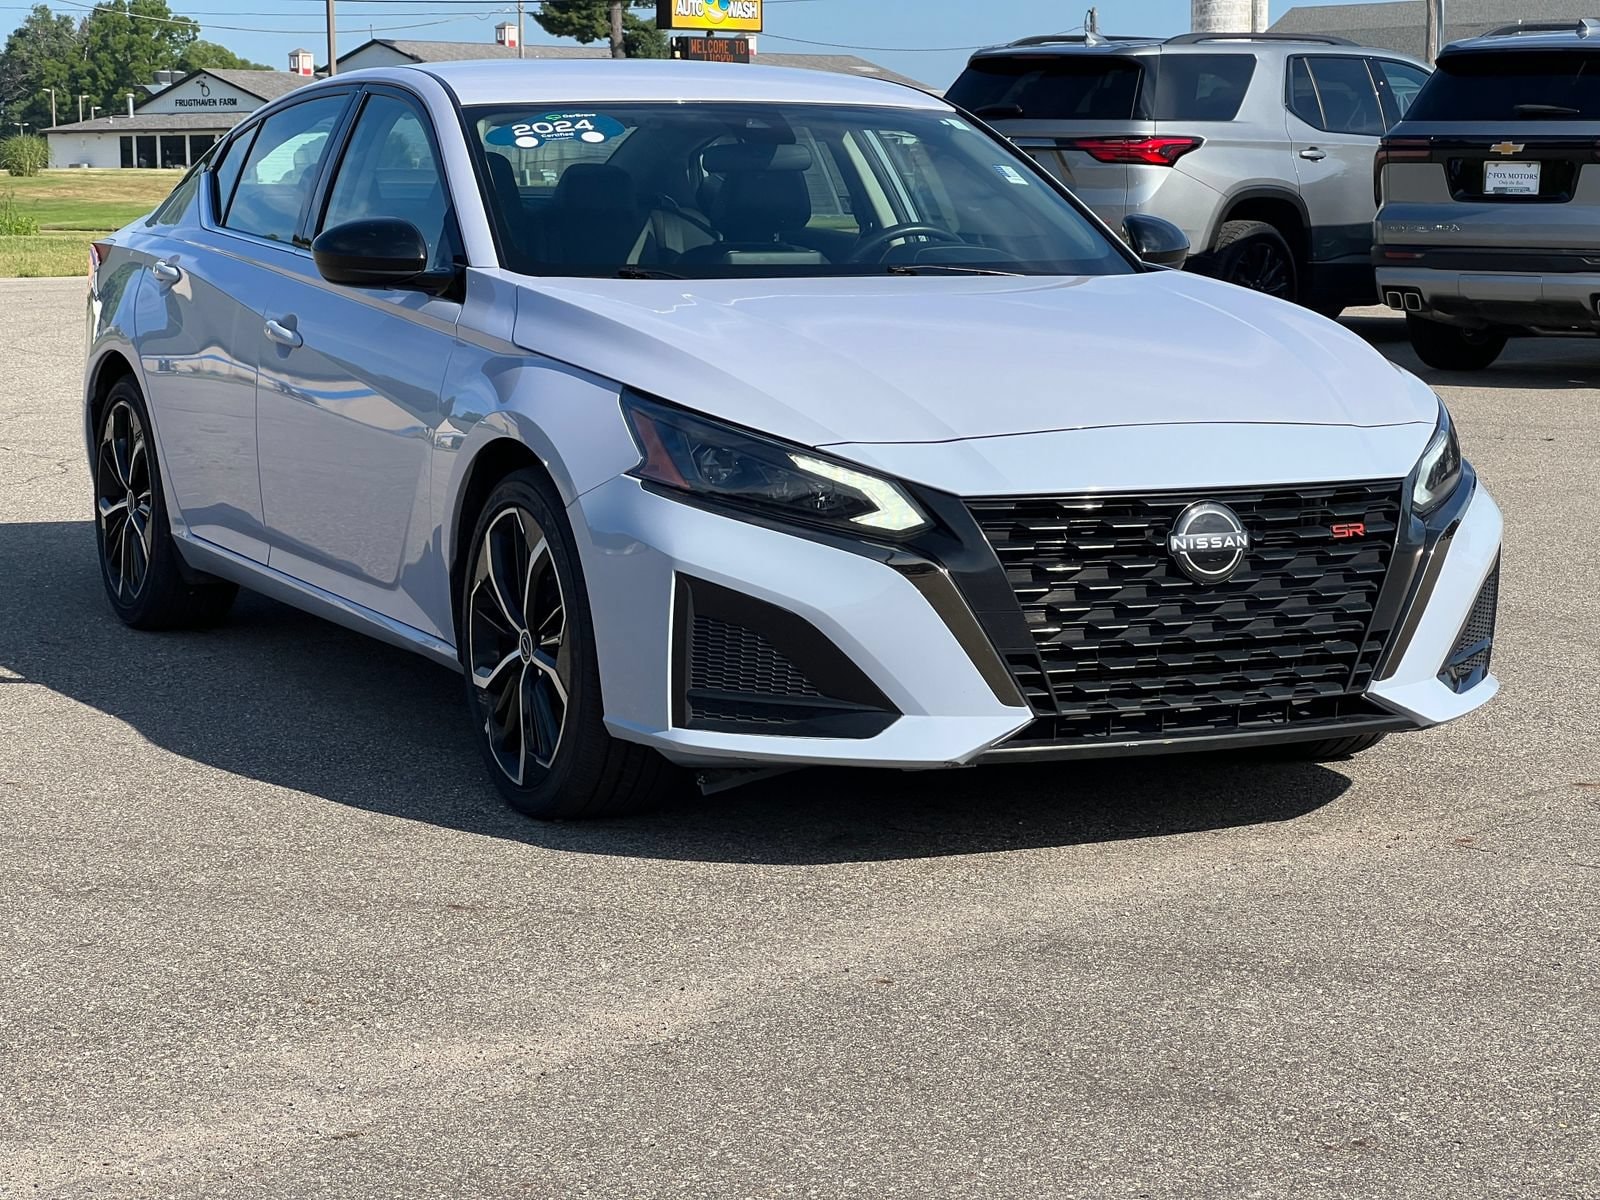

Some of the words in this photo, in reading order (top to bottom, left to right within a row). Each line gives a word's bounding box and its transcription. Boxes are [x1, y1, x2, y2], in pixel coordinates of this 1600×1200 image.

[674, 0, 705, 17] AUTO
[727, 0, 759, 19] WASH
[690, 38, 730, 55] WELCOME
[735, 40, 746, 55] TO
[174, 98, 217, 107] FRUGTHAVEN
[219, 97, 238, 106] FARM
[511, 119, 594, 137] 2024
[1331, 522, 1366, 539] SR
[1172, 534, 1248, 549] NISSAN
